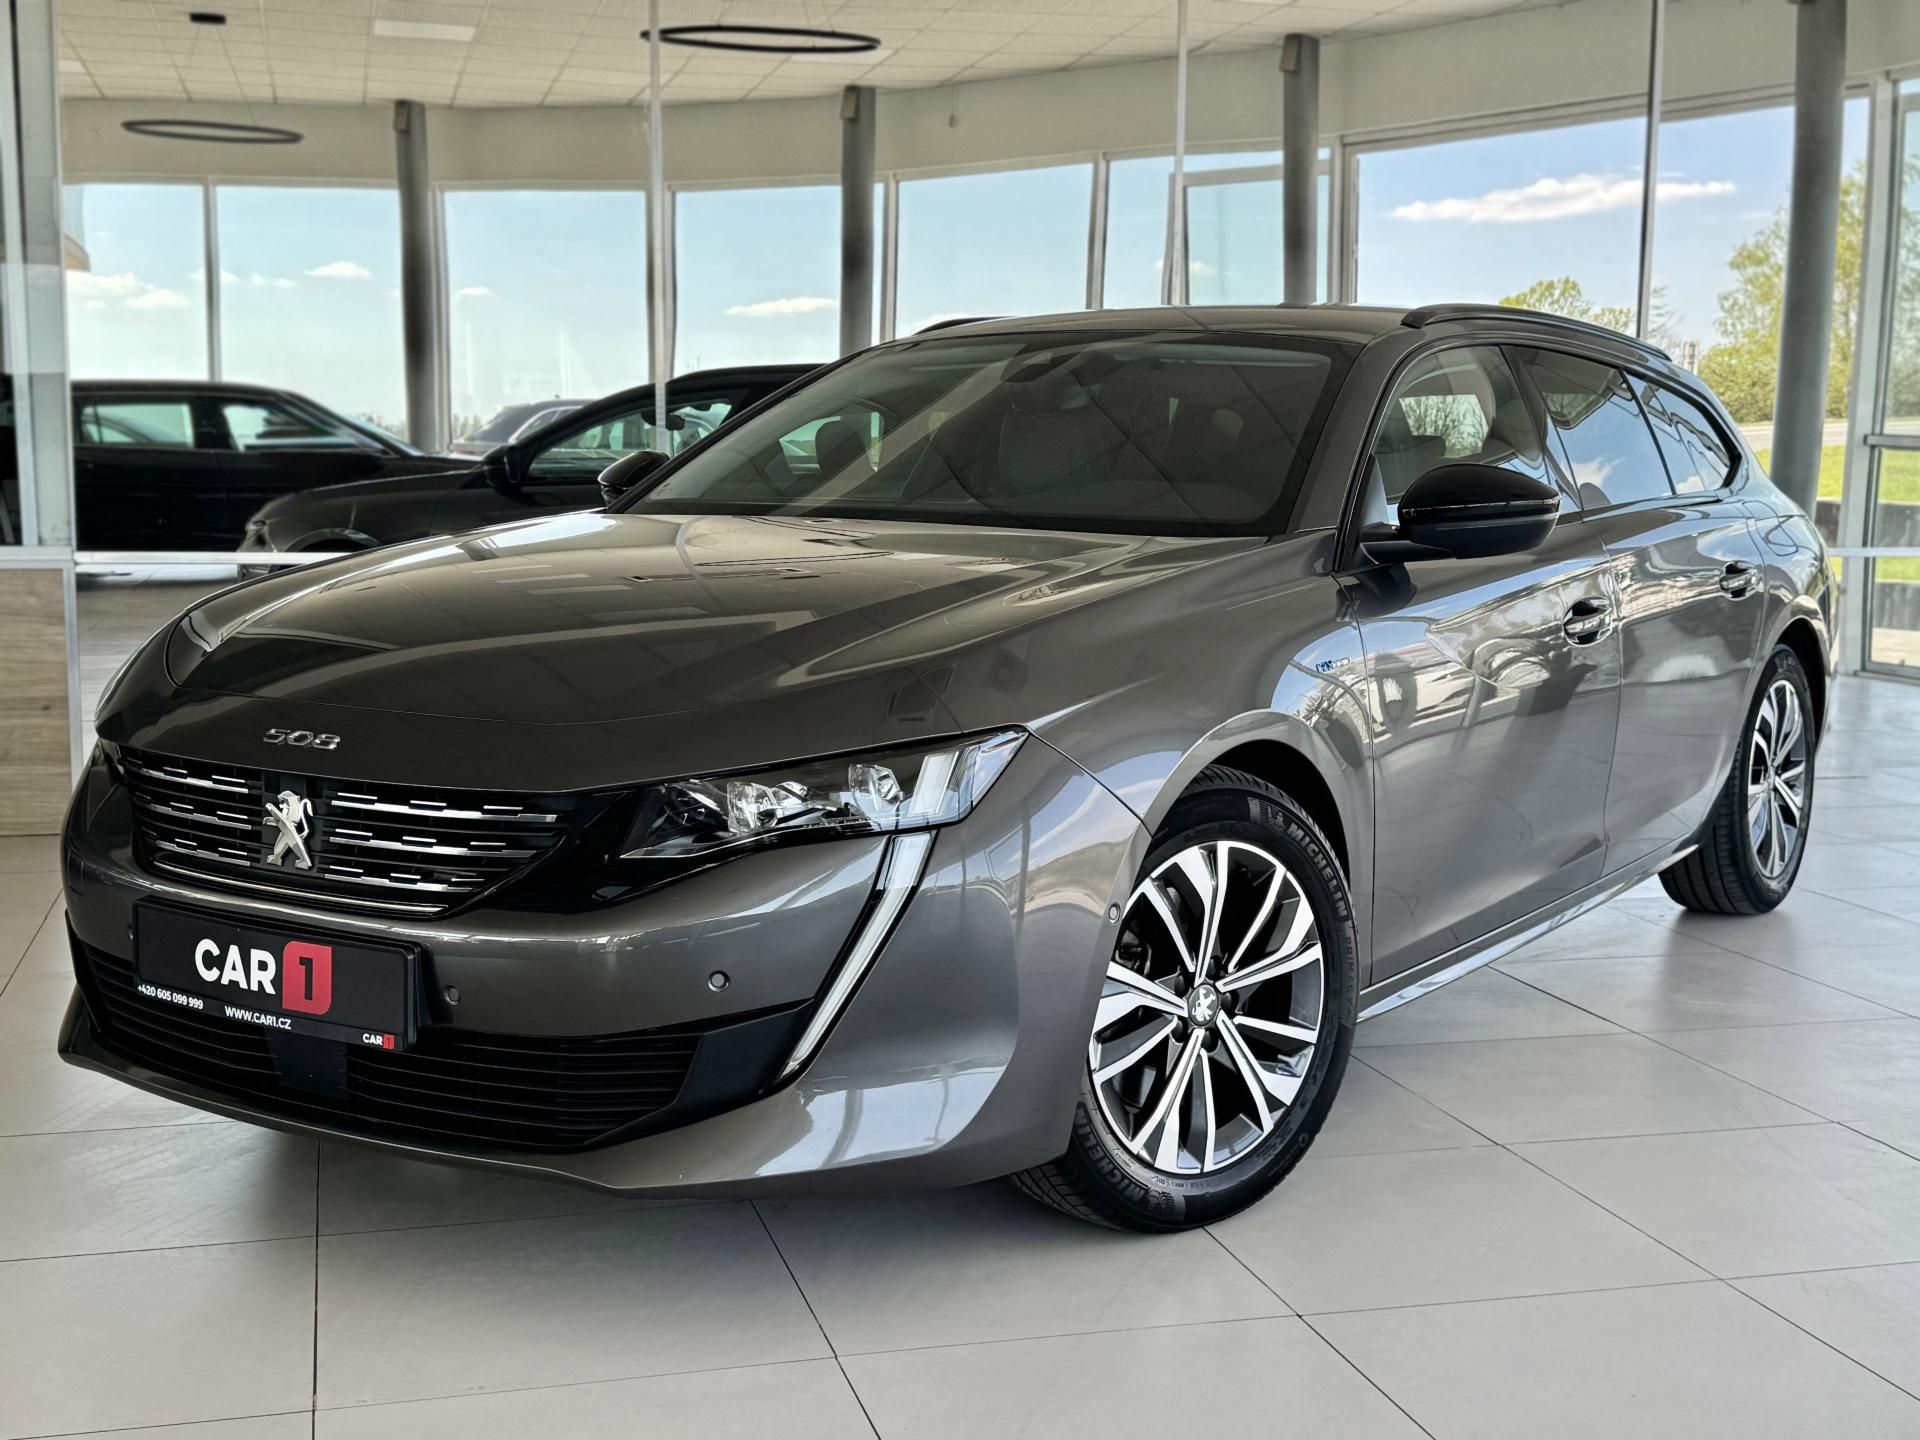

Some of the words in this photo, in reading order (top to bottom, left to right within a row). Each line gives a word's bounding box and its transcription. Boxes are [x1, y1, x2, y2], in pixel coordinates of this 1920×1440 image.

[263, 728, 341, 750] 508
[1286, 822, 1348, 918] MICHELIN
[137, 984, 156, 997] +420
[157, 988, 172, 1001] 605
[172, 992, 188, 1005] 099
[188, 997, 204, 1010] 999
[224, 1005, 292, 1031] WWW.CAR1.CZ
[1074, 1107, 1146, 1202] MICHELIN
